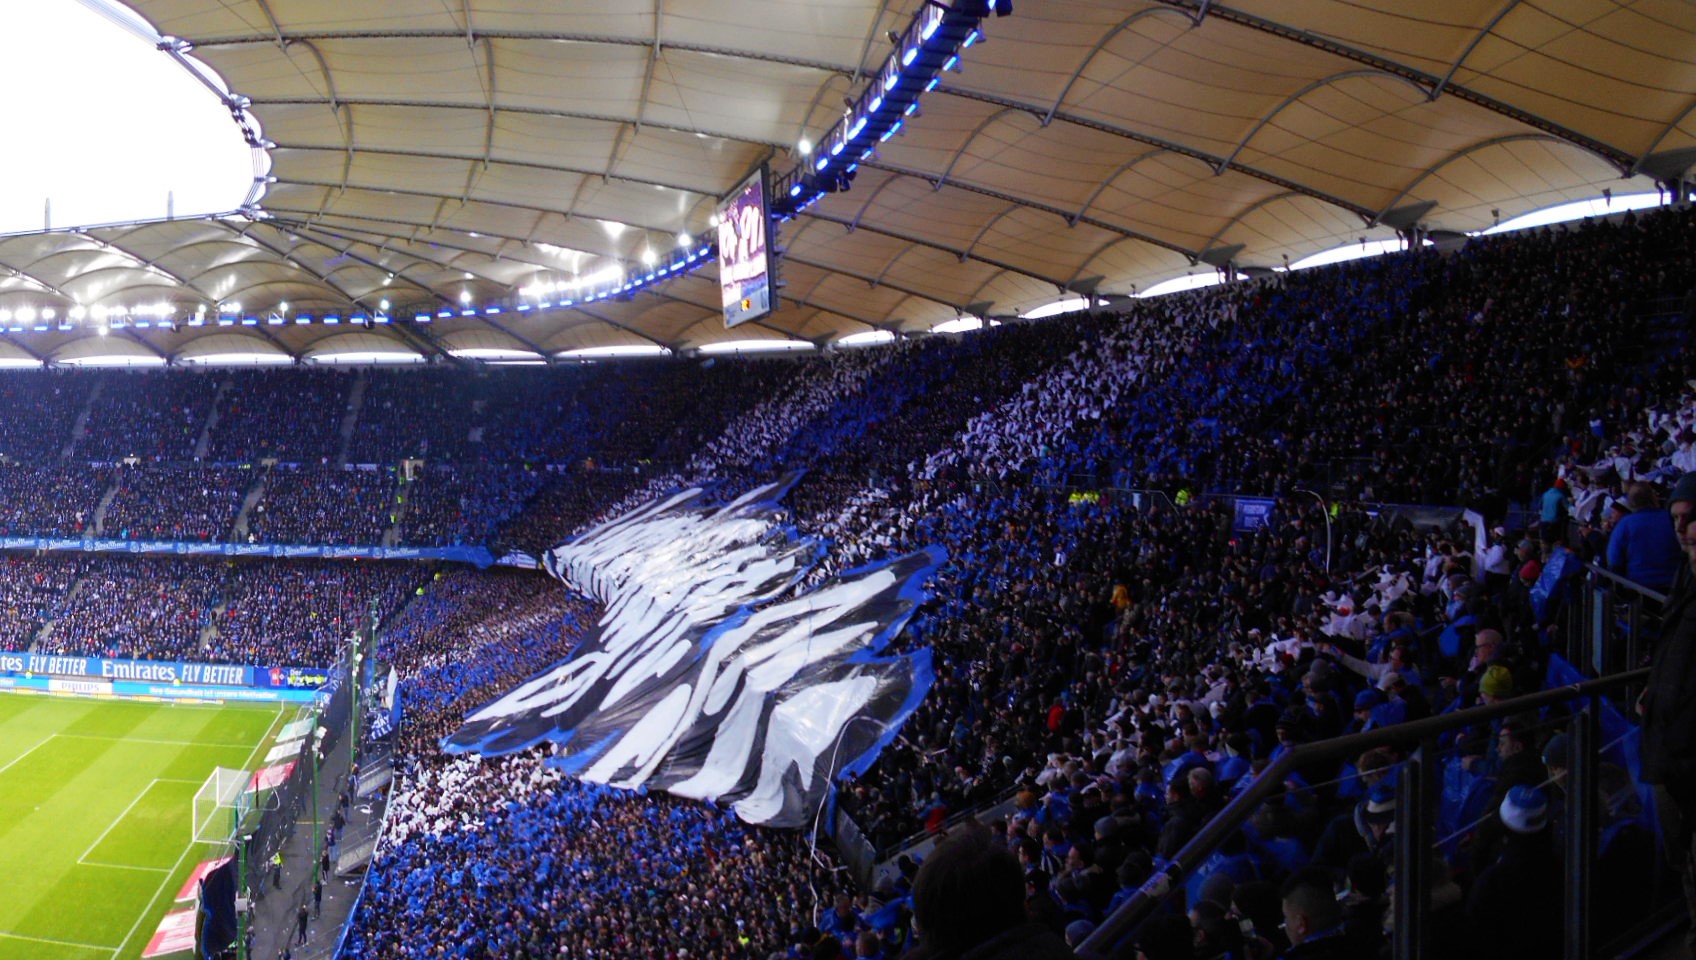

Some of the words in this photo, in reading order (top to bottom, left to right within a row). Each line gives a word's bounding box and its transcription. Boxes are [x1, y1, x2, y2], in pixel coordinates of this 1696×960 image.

[29, 655, 46, 673] FLY
[48, 657, 88, 676] BETTER
[102, 660, 176, 681] Emirates
[181, 664, 201, 682] FLY
[202, 665, 245, 684] BETTER
[61, 682, 100, 692] PHILIPS
